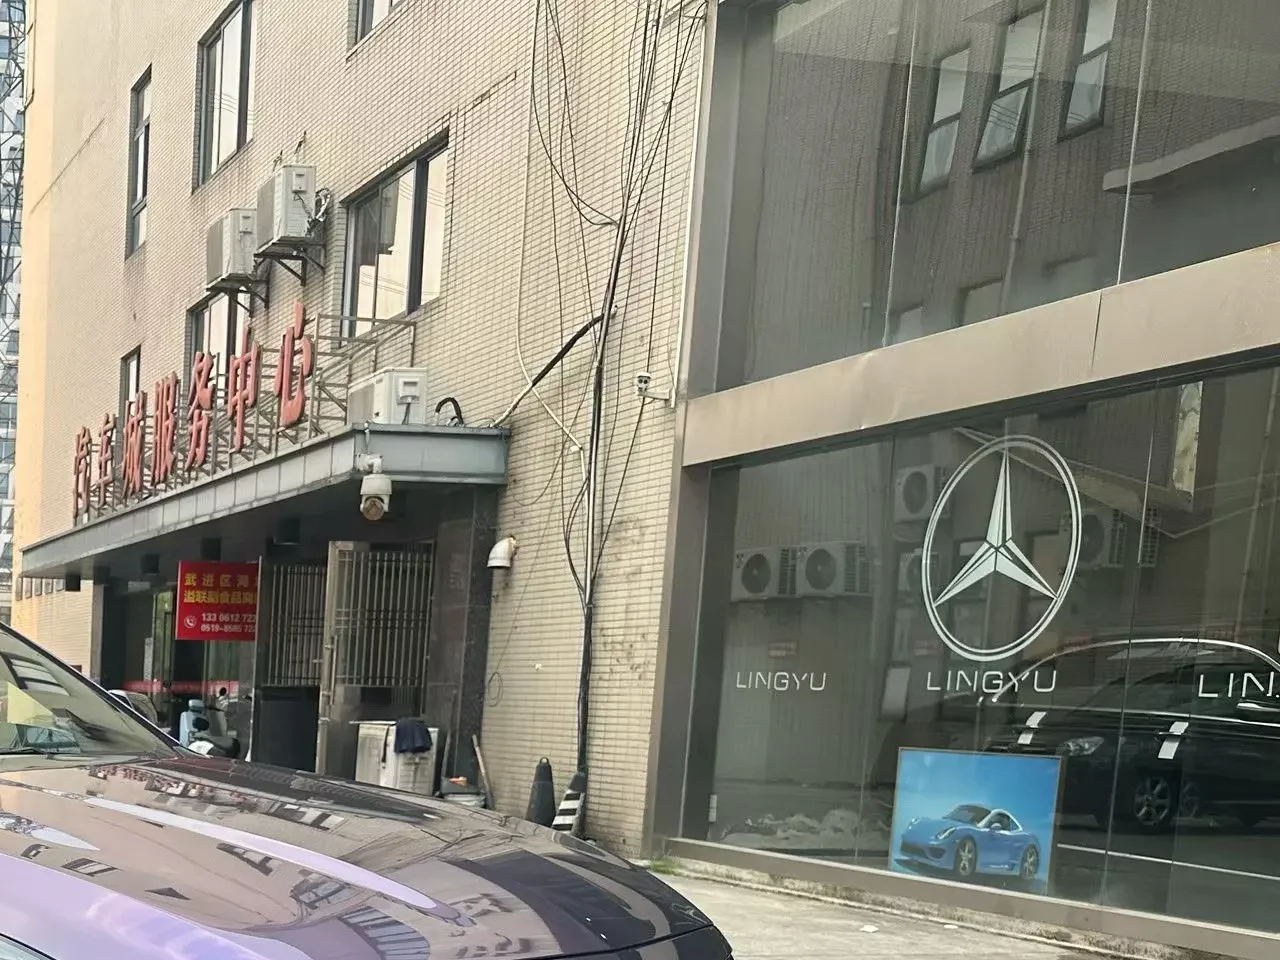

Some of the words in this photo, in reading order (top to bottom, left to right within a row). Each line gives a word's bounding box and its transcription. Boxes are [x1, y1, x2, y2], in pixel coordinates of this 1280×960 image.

[736, 671, 827, 691] LINGYU
[926, 669, 1057, 693] LINGYU
[1198, 671, 1280, 698] LIN
